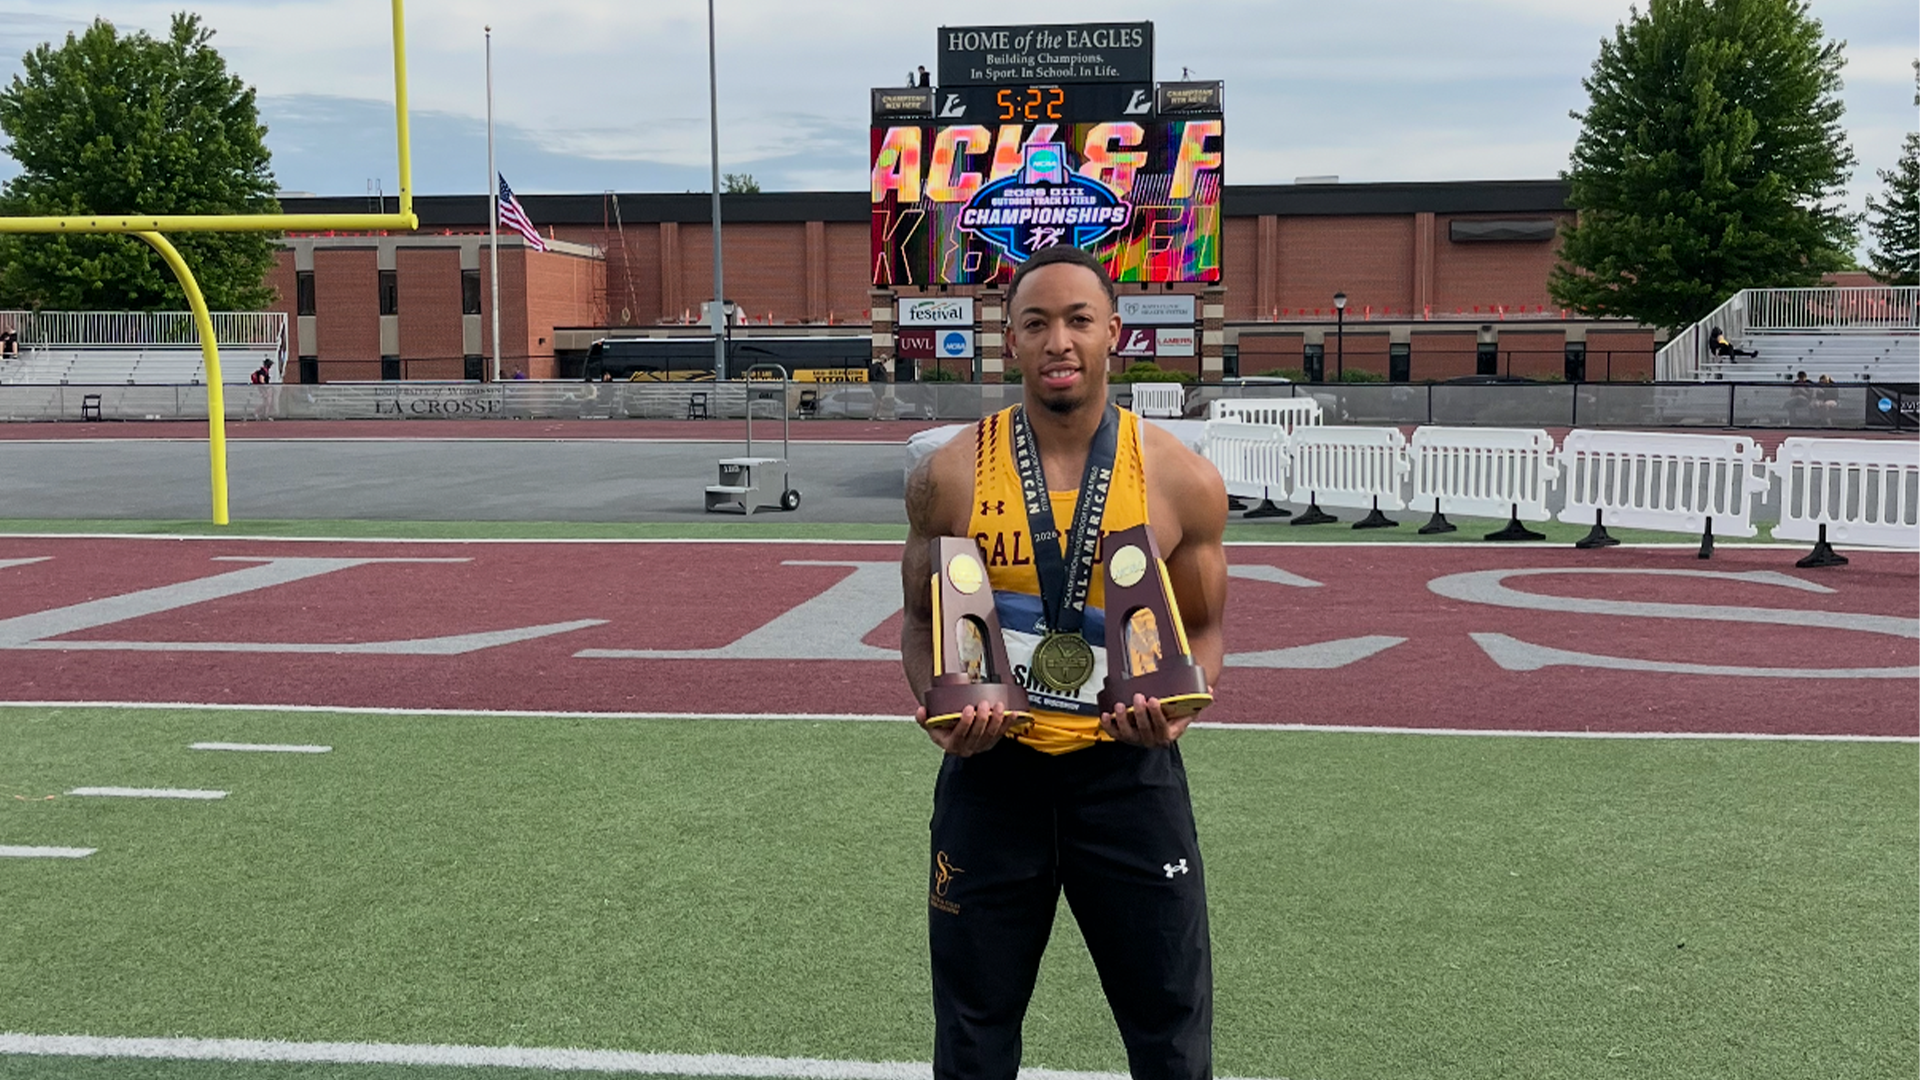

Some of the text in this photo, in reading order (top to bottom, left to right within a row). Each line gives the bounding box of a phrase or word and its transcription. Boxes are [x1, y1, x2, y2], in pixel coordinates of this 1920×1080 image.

[948, 28, 1143, 55] HOME of the EAGLES
[986, 52, 1104, 66] Building Champions.
[970, 65, 1120, 80] In Sport. In School. In Life.
[997, 88, 1065, 120] 5:22
[1033, 196, 1061, 205] TRACK
[1071, 196, 1096, 205] FIELD
[963, 207, 1125, 225] CHAMPIONSHIPS
[909, 304, 963, 321] festival
[901, 338, 933, 350] UWL
[411, 399, 501, 414] CROSSE
[1072, 468, 1112, 612] ALL-AMERICAN
